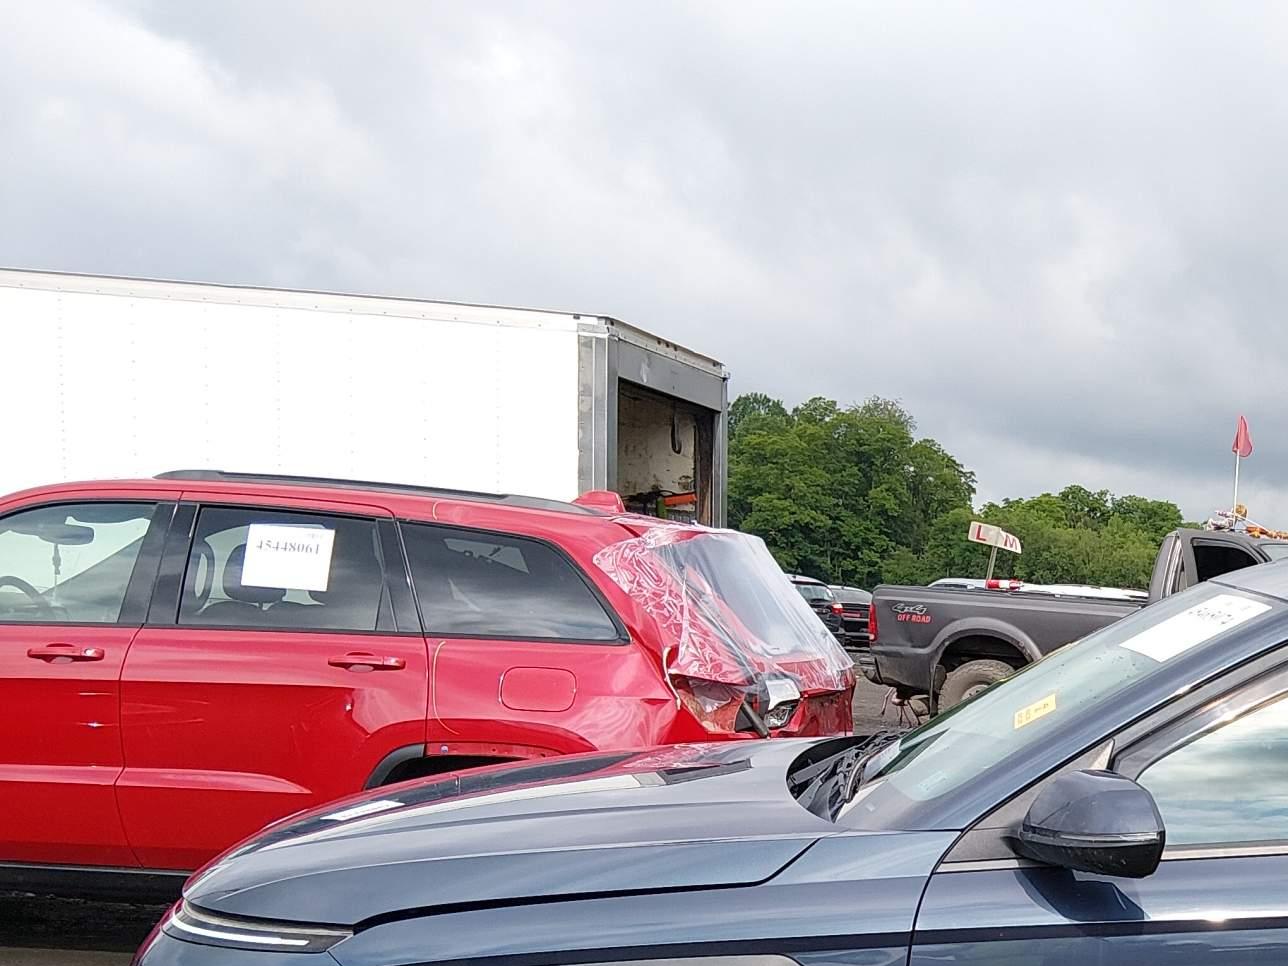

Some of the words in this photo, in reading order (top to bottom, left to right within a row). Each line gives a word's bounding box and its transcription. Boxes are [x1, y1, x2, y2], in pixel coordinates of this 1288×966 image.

[256, 538, 320, 555] 45448061
[897, 613, 911, 622] OFF
[911, 614, 932, 624] ROAD
